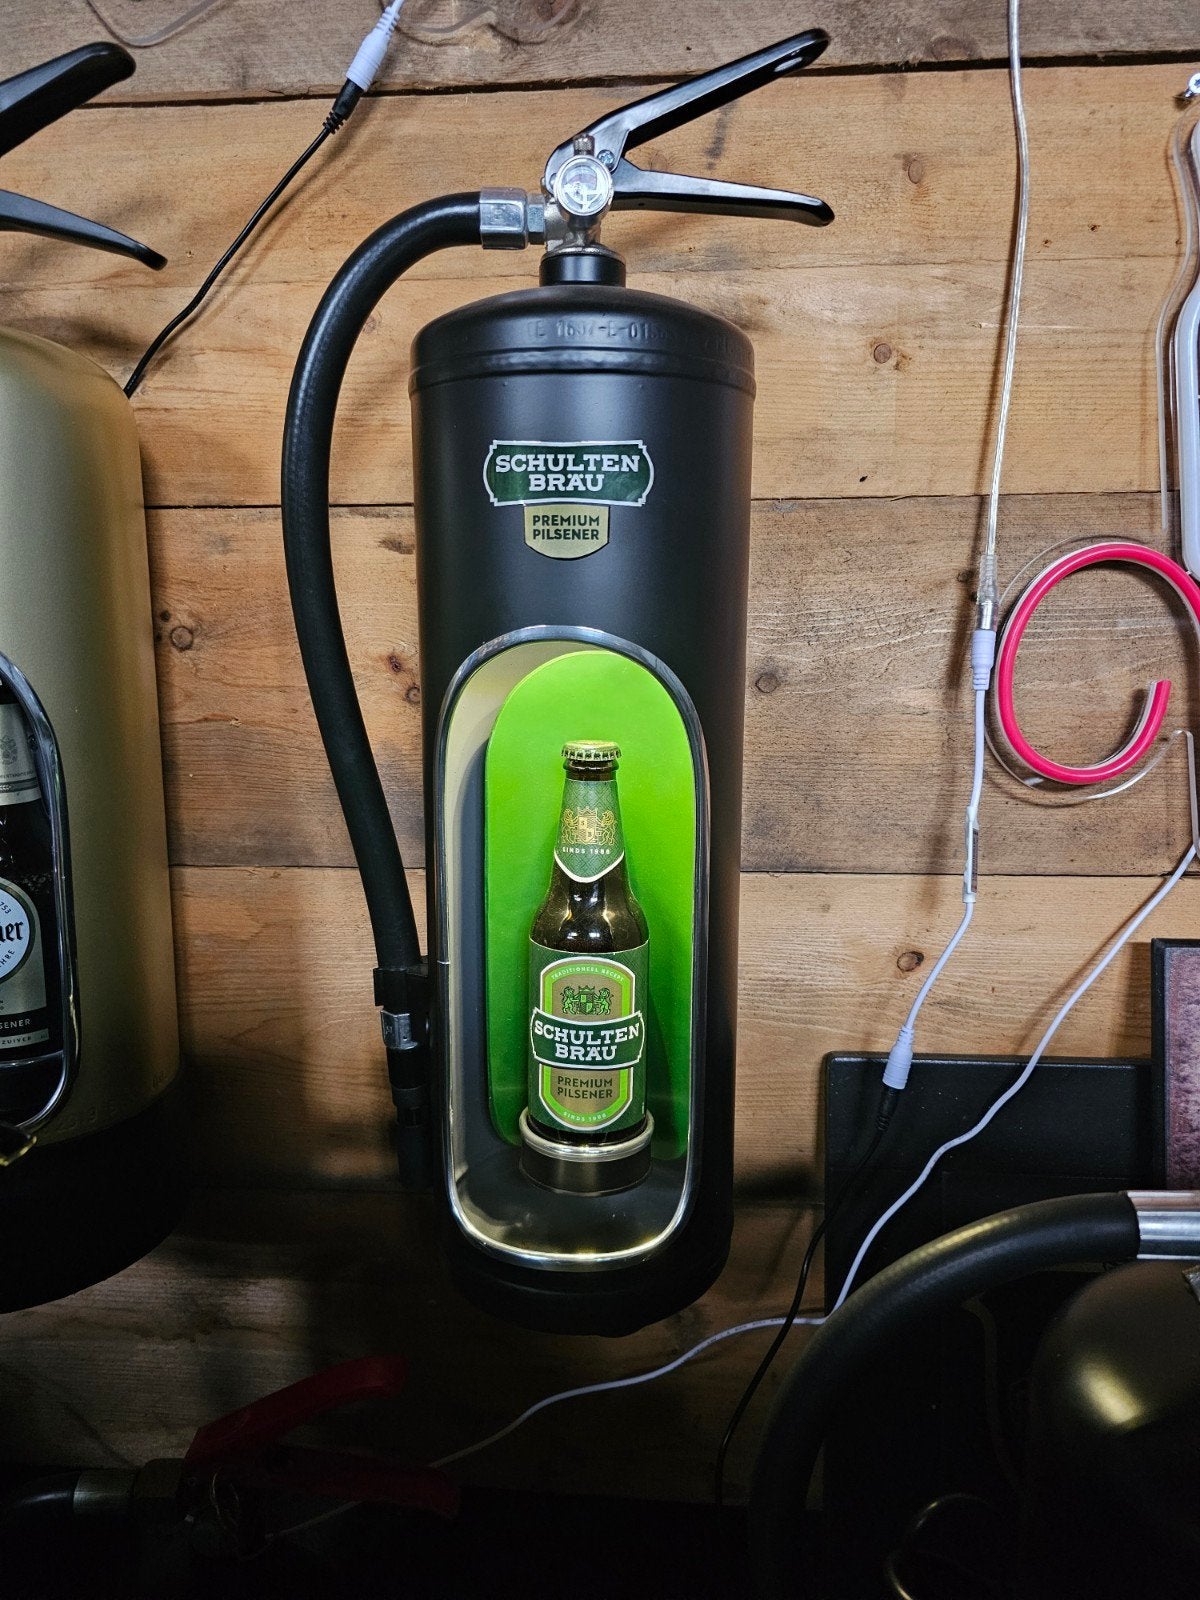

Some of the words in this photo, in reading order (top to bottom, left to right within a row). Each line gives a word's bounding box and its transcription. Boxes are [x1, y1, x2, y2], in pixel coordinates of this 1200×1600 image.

[495, 453, 640, 473] SCHULTEN
[528, 473, 605, 492] BRÄU
[532, 514, 600, 526] PREMIUM
[532, 528, 600, 540] PILSENER
[562, 846, 586, 854] SINDS
[0, 921, 24, 942] er
[551, 966, 599, 979] TRADITIONEEL
[601, 968, 625, 982] RECEPT
[534, 1020, 640, 1045] SCHULTEN
[555, 1042, 618, 1061] BRÄU
[557, 1076, 613, 1088] PREMIUM
[557, 1086, 613, 1099] PILSENER
[563, 1111, 586, 1122] SINDS
